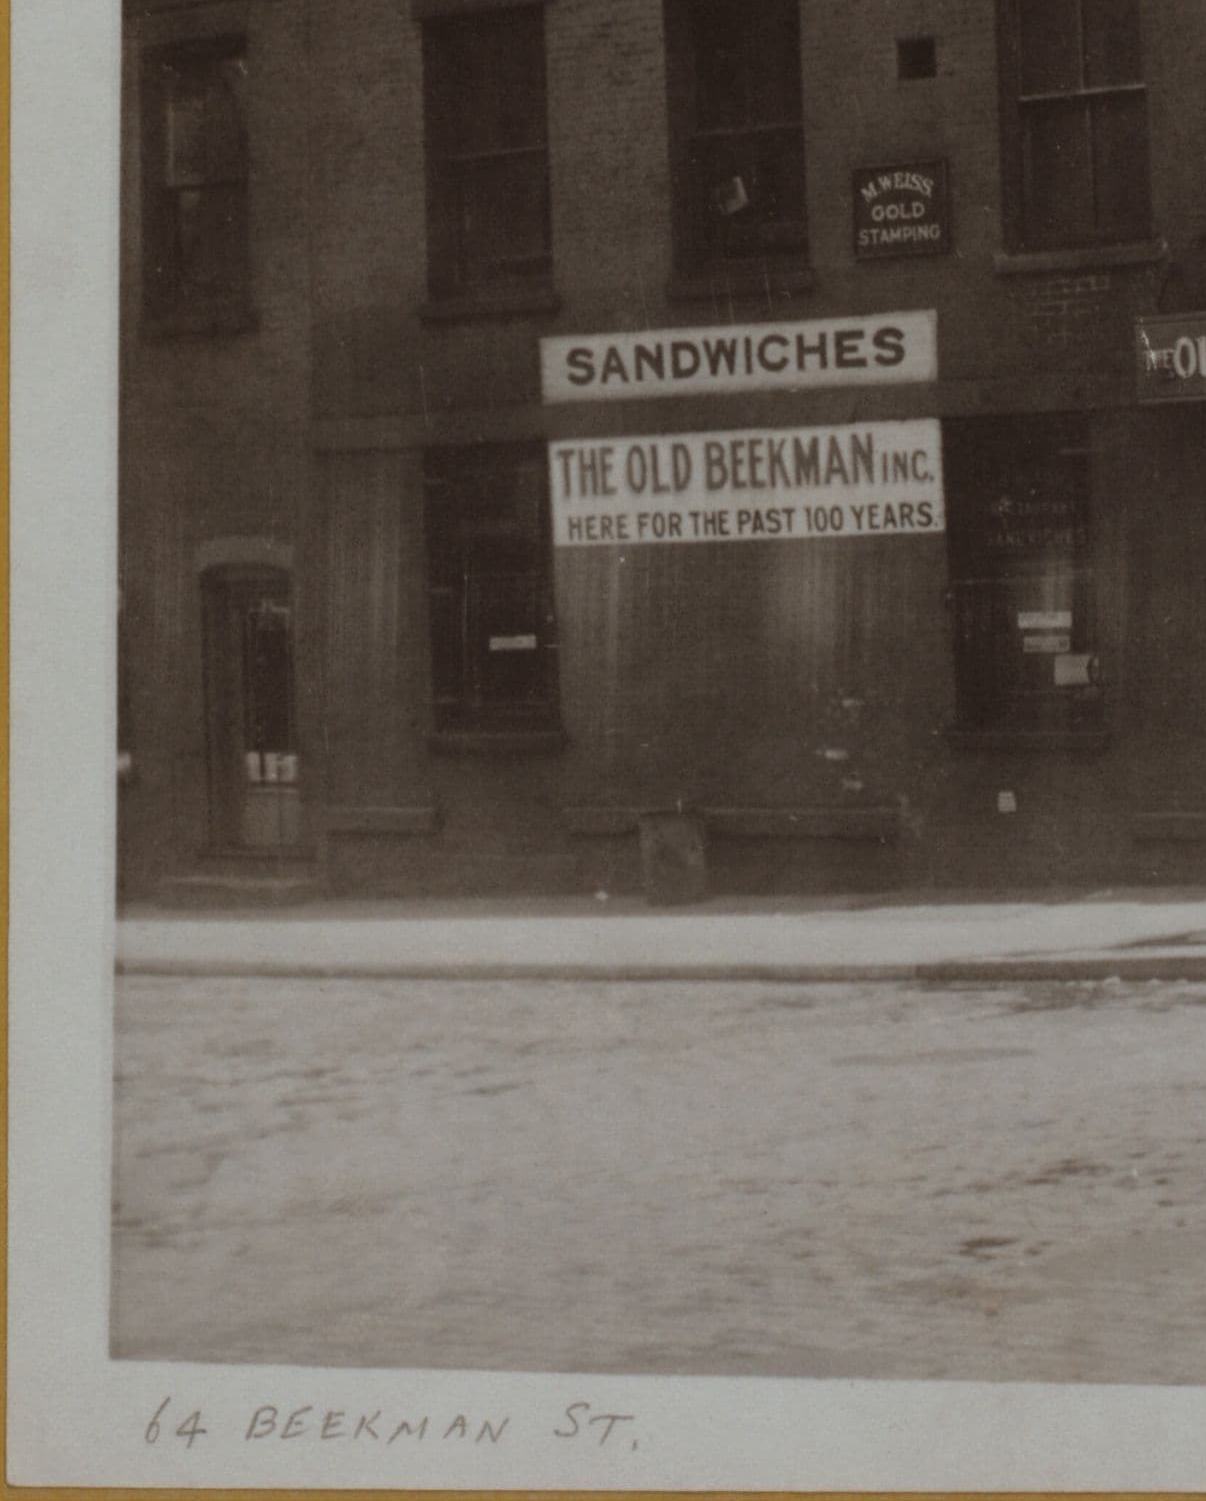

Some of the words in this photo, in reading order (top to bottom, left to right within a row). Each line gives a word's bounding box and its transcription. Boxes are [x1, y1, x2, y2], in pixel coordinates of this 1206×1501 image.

[871, 201, 925, 221] GOLD
[858, 223, 941, 246] STAMPING
[565, 327, 906, 386] SANDWICHES
[557, 446, 618, 498] THE
[626, 442, 692, 495] OLD
[704, 432, 875, 492] BEEKMAN
[881, 450, 935, 484] INC.
[567, 513, 629, 541] HERE
[638, 511, 682, 538] FOR
[688, 509, 729, 537] THE
[737, 507, 796, 535] PAST
[805, 504, 844, 533] 100
[143, 1395, 208, 1446] 64
[245, 1403, 510, 1444] BEEKMAN
[553, 1401, 641, 1451] ST.
